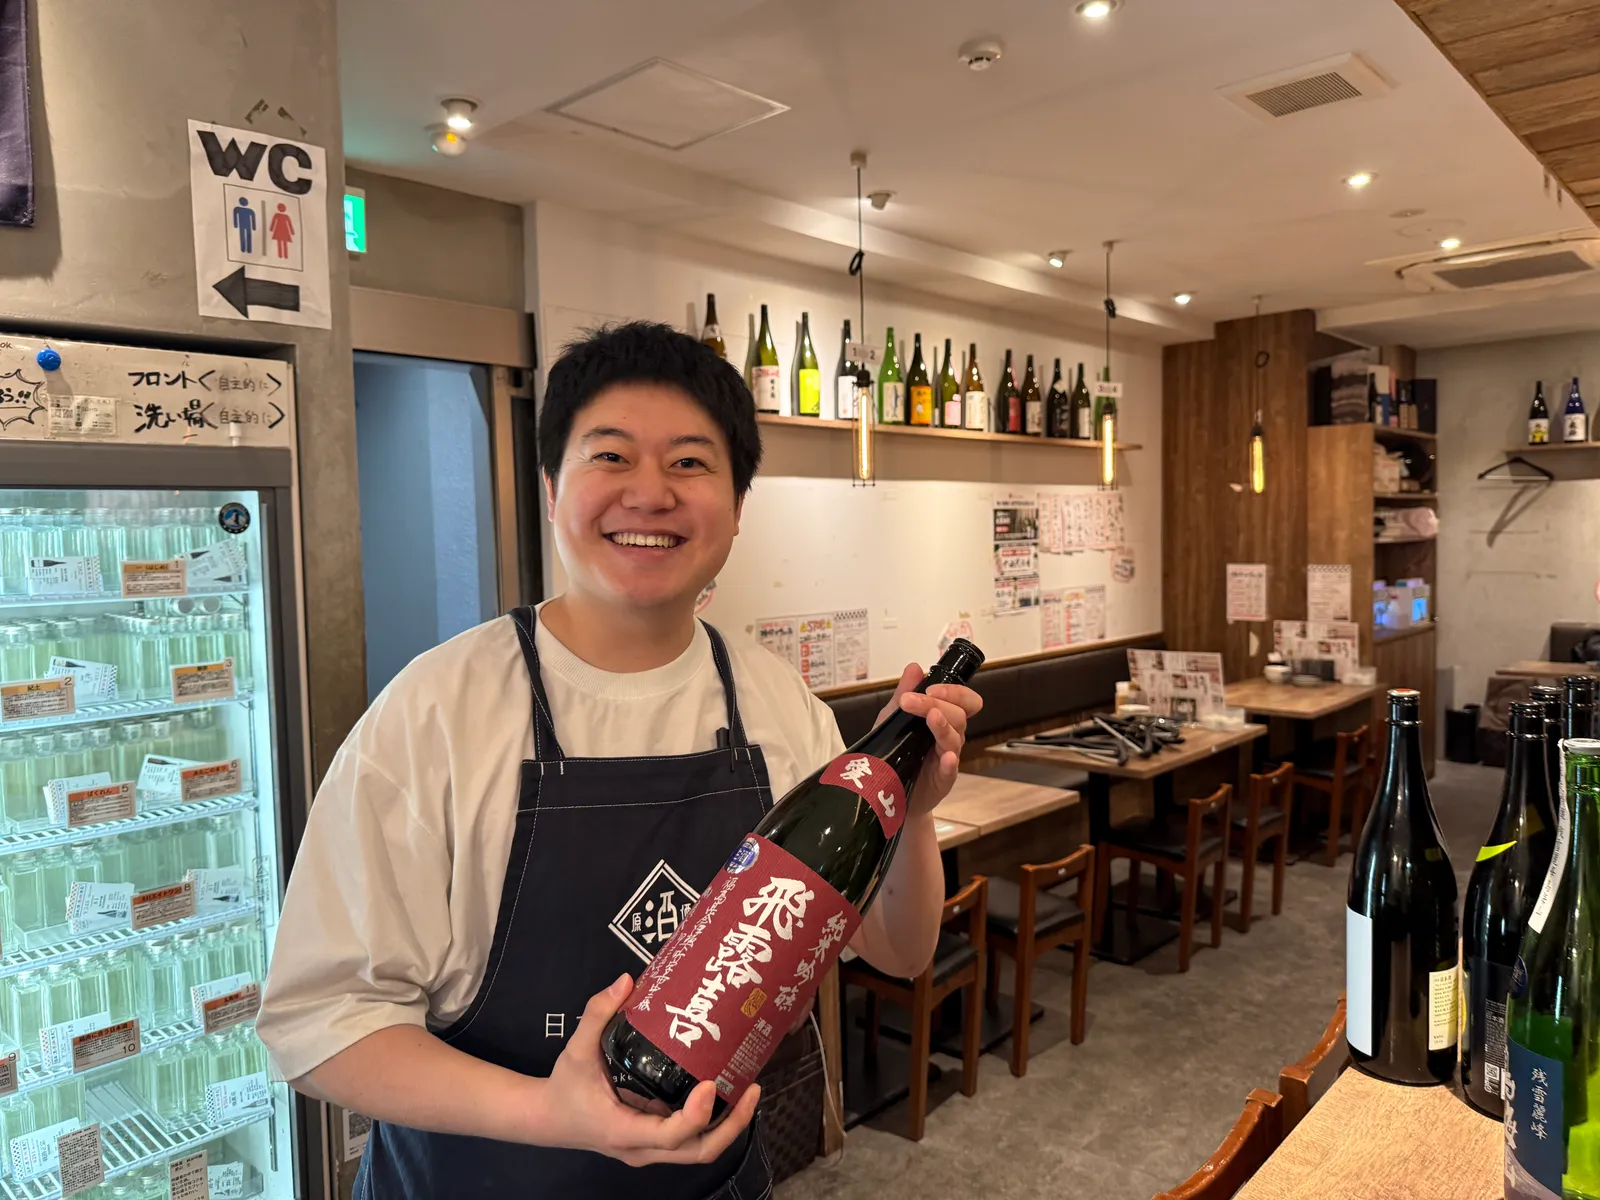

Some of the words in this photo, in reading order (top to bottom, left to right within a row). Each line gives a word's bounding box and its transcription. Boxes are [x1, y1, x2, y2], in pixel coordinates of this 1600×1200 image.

[196, 130, 313, 195] WC
[174, 560, 179, 569] 1
[225, 658, 232, 668] 3
[64, 676, 72, 686] 2
[231, 759, 238, 769] 6
[121, 783, 129, 794] 5
[184, 884, 191, 893] 8
[665, 877, 815, 1048] 飛露喜
[753, 1017, 773, 1037] 清酒
[122, 1043, 136, 1055] 10
[8, 1052, 17, 1061] 9
